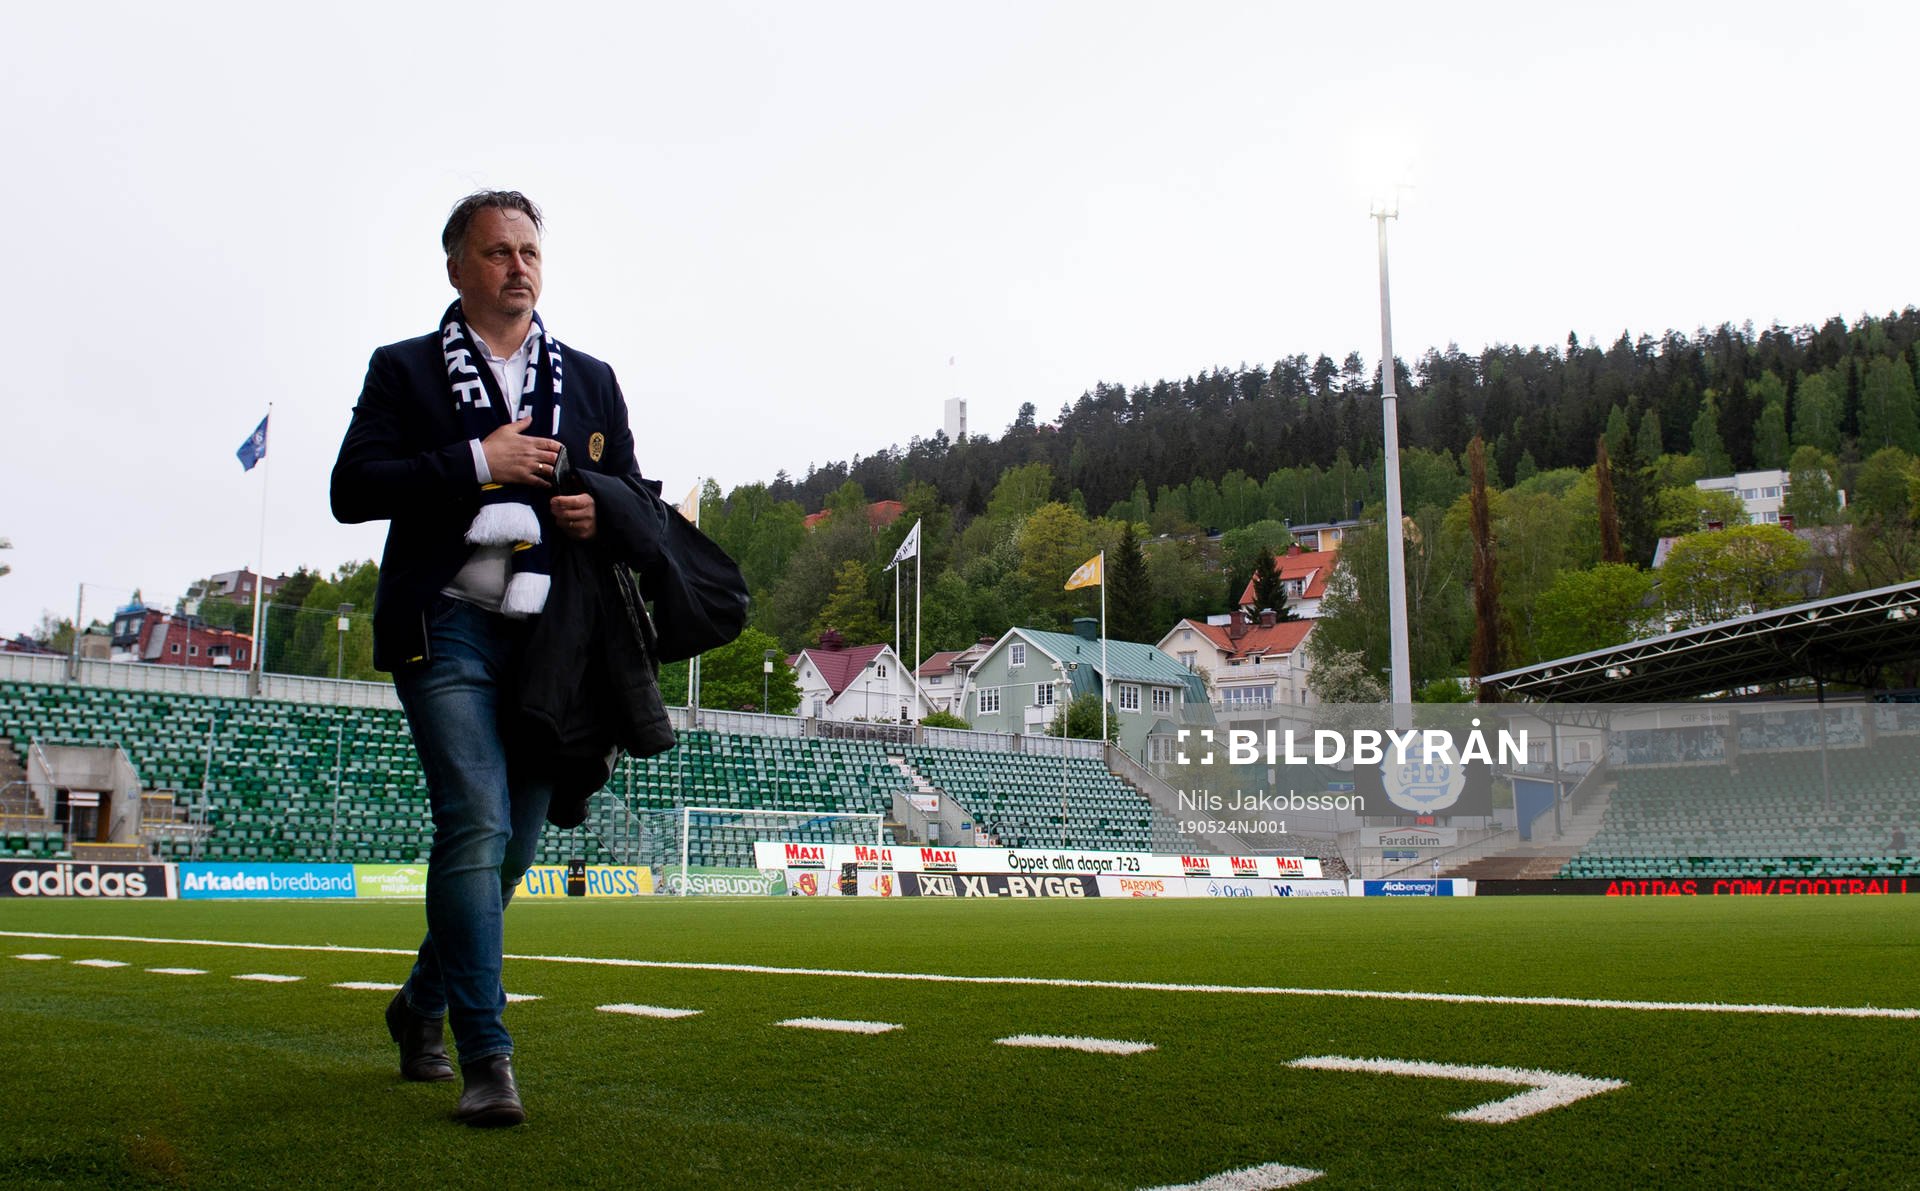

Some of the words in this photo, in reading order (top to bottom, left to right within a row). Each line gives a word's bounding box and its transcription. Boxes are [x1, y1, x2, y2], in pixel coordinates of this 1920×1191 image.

[1379, 835, 1440, 846] Faradium
[784, 843, 825, 860] MAXI
[920, 847, 957, 863] MAXI
[1007, 850, 1049, 873] Öppet
[1052, 855, 1074, 870] alla
[1077, 855, 1113, 874] dagar
[1116, 856, 1141, 872] 7-23
[1181, 855, 1210, 869] MAXI
[1230, 856, 1258, 869] MAXI
[1276, 857, 1303, 870] MAXI
[11, 863, 148, 896] adidas
[587, 869, 639, 895] ROSS
[960, 876, 1085, 897] XL-BYGG
[1120, 878, 1164, 892] PARSONS
